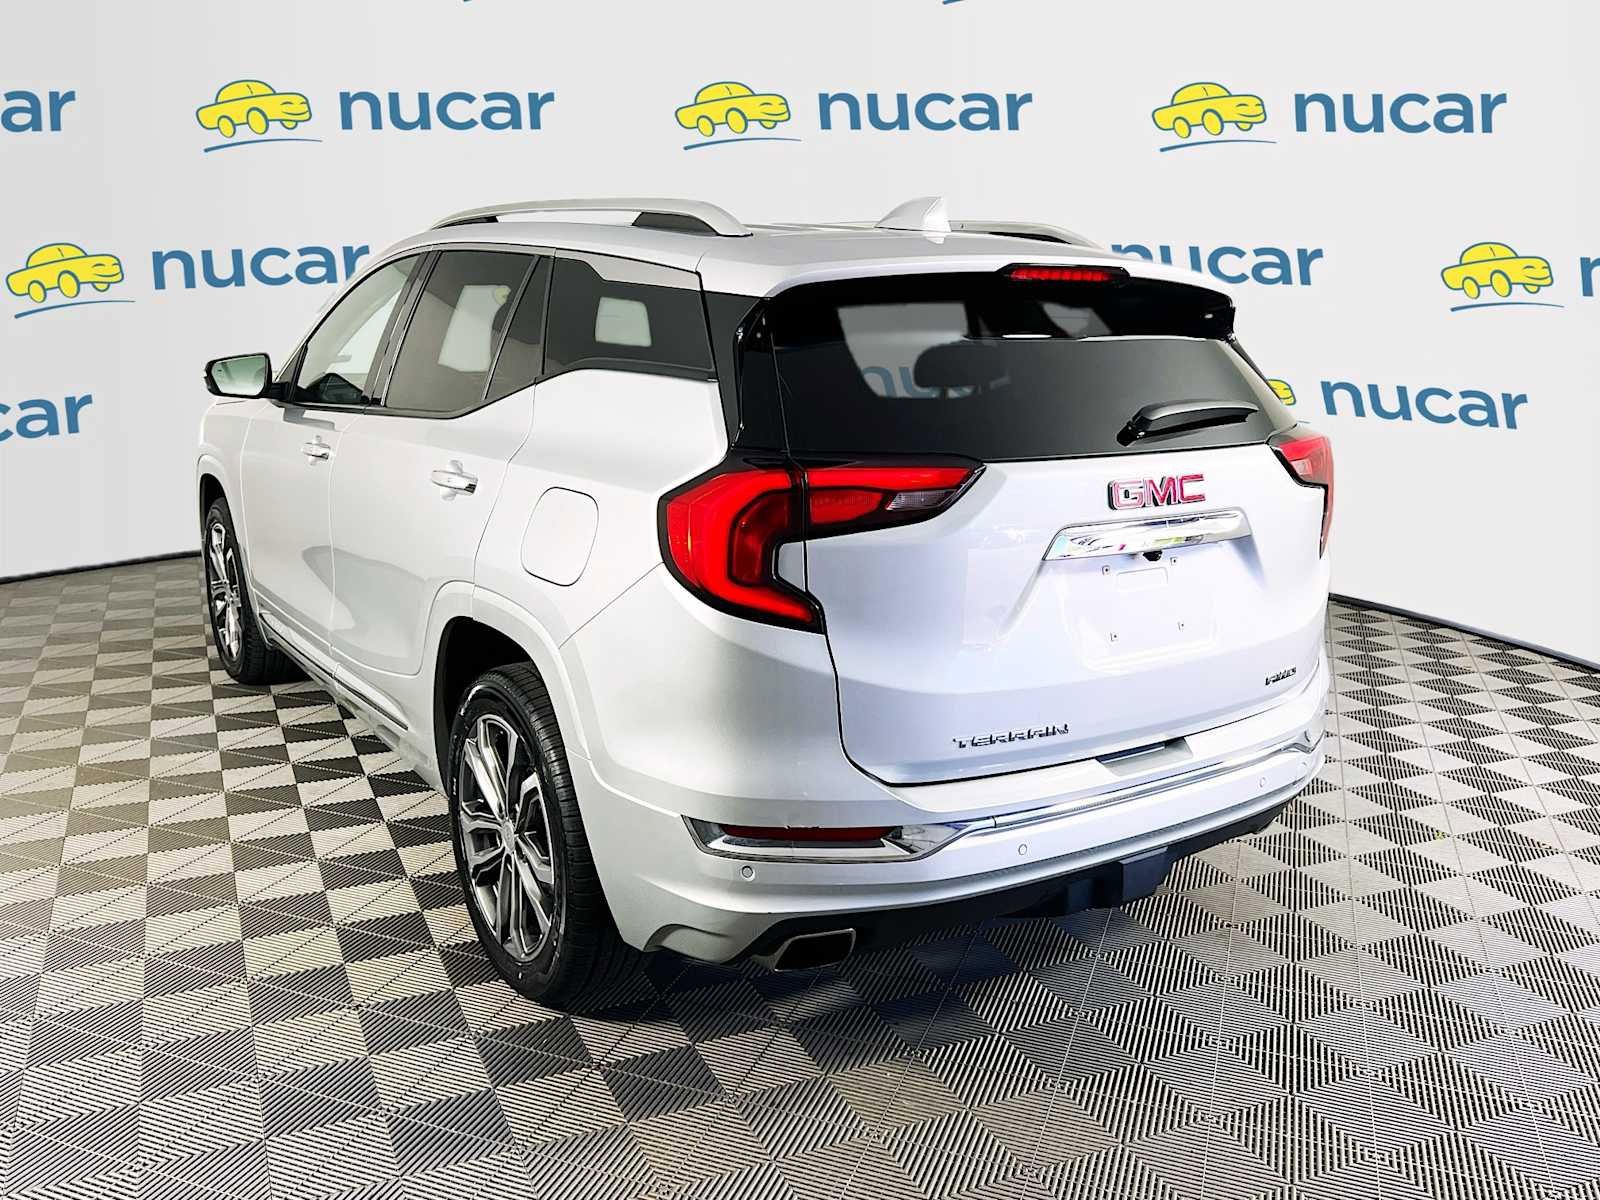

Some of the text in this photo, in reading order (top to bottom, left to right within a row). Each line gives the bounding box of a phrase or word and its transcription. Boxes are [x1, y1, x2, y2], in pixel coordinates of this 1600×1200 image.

[339, 90, 556, 131] nucar
[818, 91, 1033, 132] nucar
[1294, 92, 1508, 134] nucar
[152, 245, 369, 290] nucar
[1320, 380, 1529, 430] nucar
[1107, 473, 1206, 511] GMC
[952, 722, 1069, 749] TERRAIN
